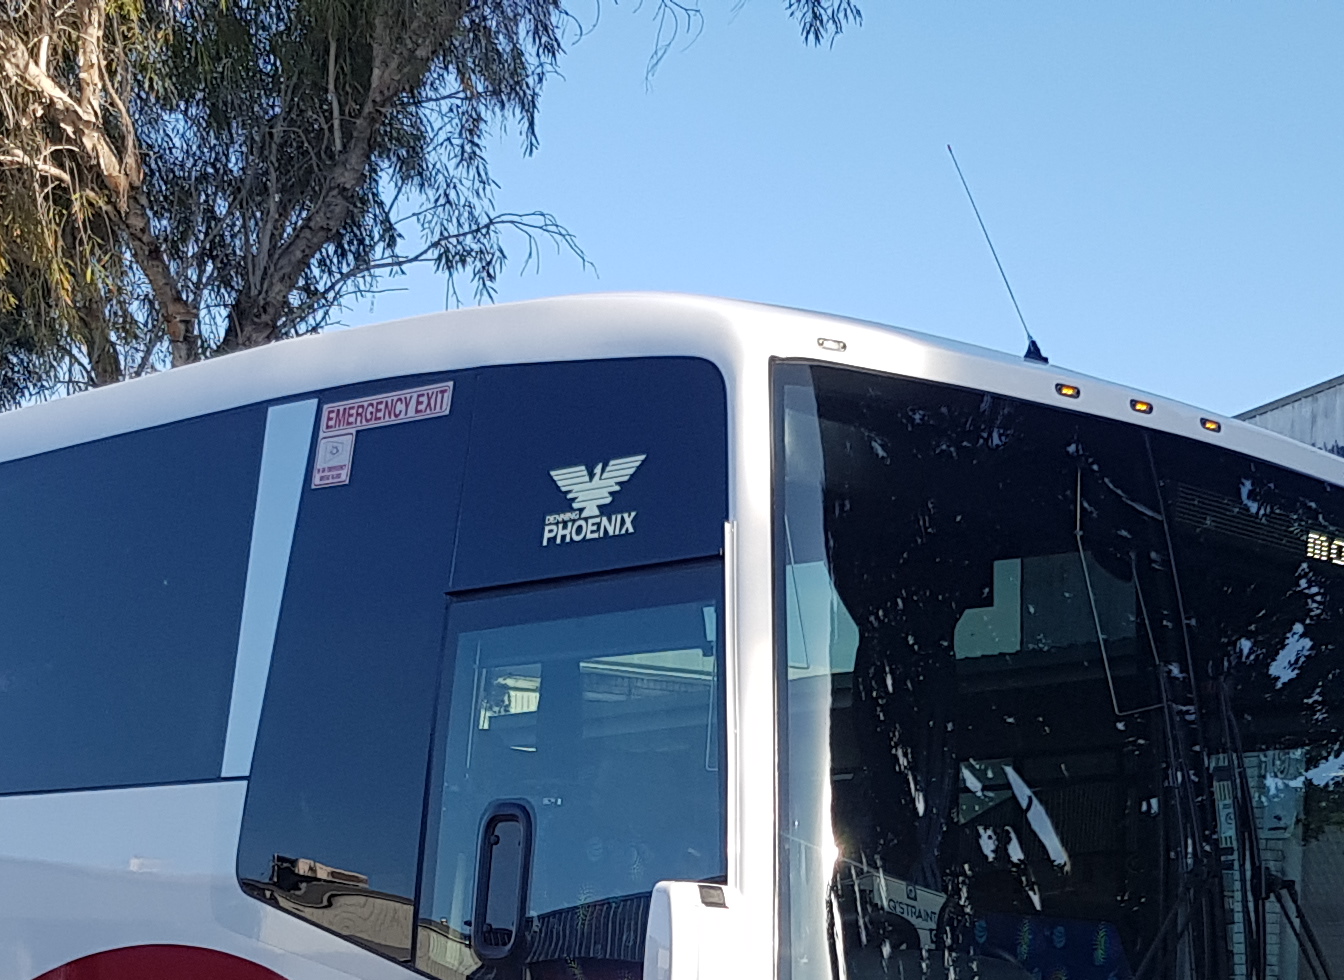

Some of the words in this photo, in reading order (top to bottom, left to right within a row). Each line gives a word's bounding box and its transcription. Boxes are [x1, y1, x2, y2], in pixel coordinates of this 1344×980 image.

[325, 395, 413, 430] EMERGENCY
[415, 388, 448, 415] EXIT
[542, 511, 637, 547] PHOENIX
